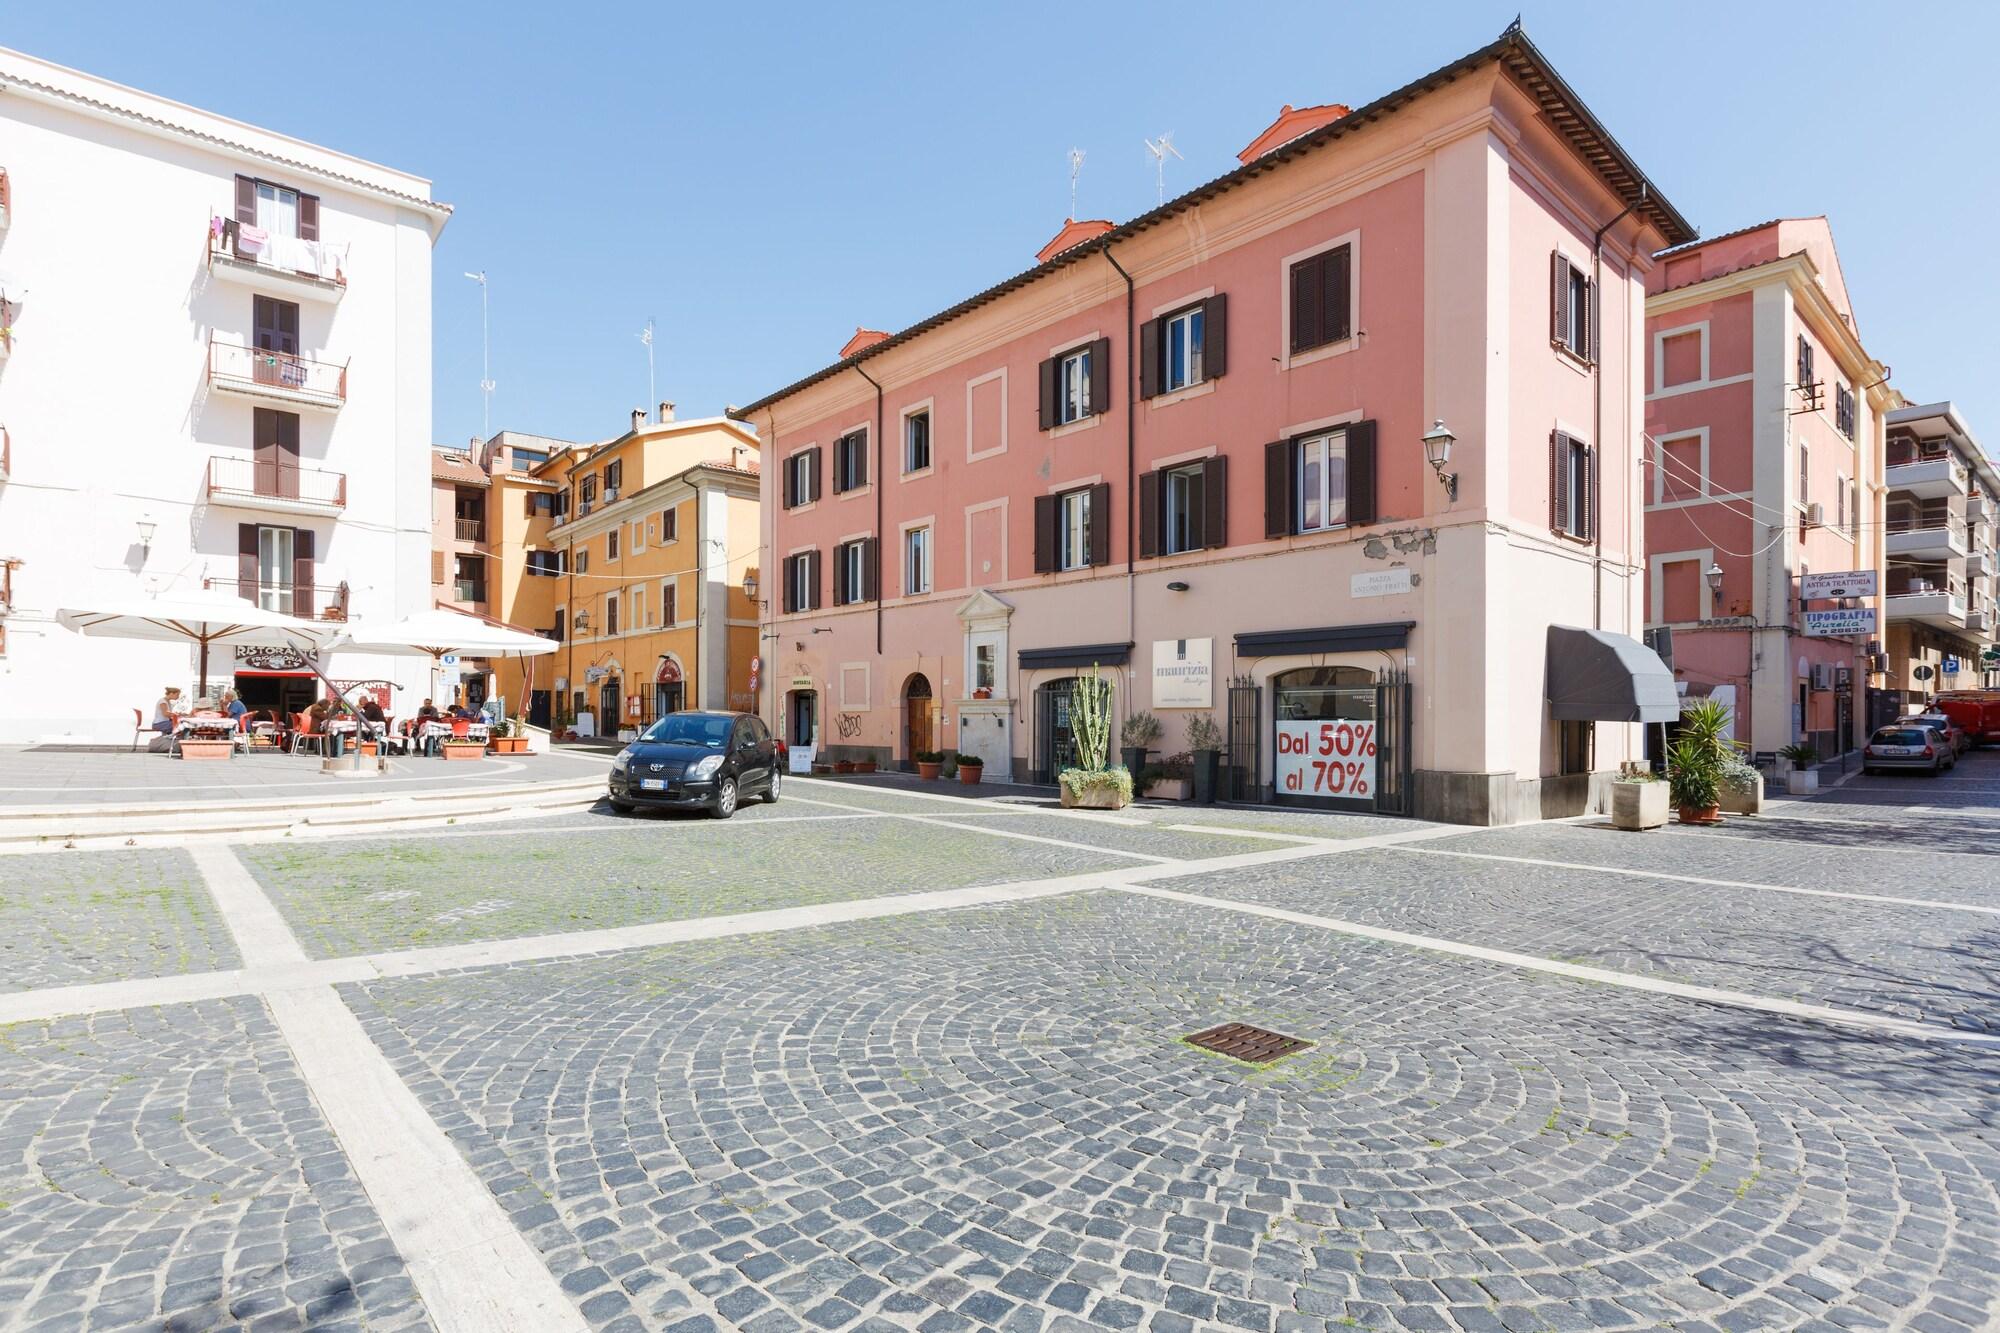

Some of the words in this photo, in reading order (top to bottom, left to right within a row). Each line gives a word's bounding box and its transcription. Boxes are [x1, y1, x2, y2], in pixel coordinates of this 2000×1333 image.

[1806, 580, 1831, 589] ANTICA
[1832, 578, 1871, 587] TRATTORIA
[1807, 610, 1874, 622] TIPOGRAFIA
[1945, 662, 1956, 672] P
[1279, 731, 1309, 754] Dal
[1318, 723, 1376, 756] 50%
[1286, 767, 1303, 790] al
[1312, 761, 1368, 794] 70%
